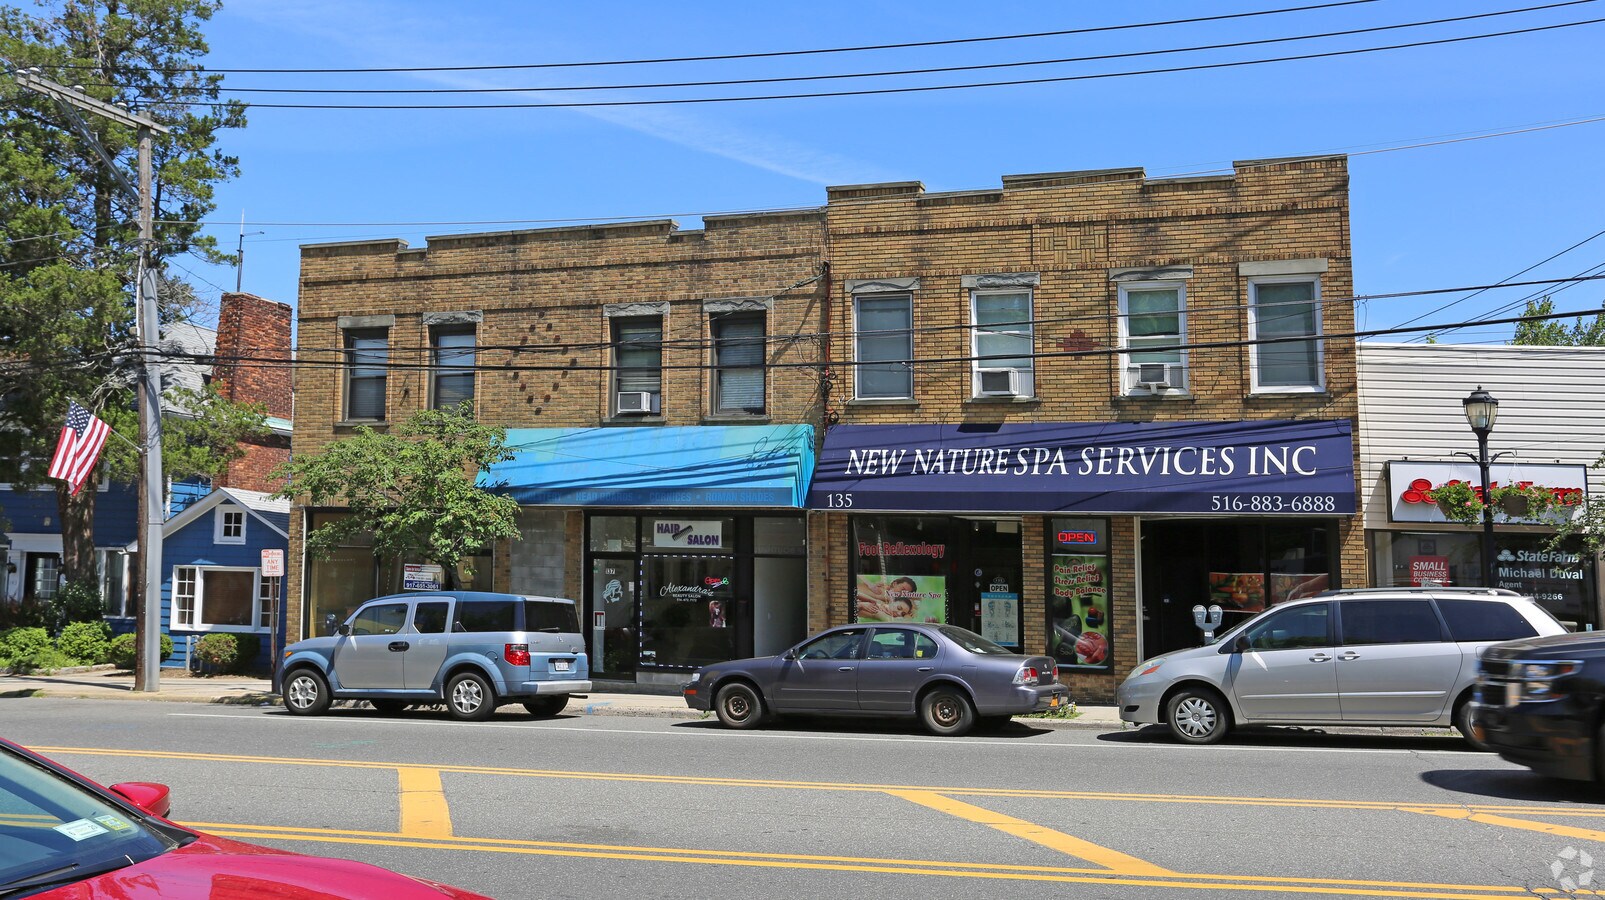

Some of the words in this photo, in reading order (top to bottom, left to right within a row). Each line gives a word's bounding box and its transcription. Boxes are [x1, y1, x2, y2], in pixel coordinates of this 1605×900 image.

[844, 448, 907, 475] NEW
[910, 448, 1011, 476] NATURE
[1013, 447, 1069, 476] SPA
[1078, 446, 1235, 476] SERVICES
[1247, 445, 1317, 476] INC
[705, 491, 737, 502] ROMAN
[740, 491, 775, 502] SHADES
[827, 493, 853, 508] 135
[1211, 495, 1336, 512] 516-883-6888
[656, 523, 681, 534] HAIR
[687, 534, 719, 546] SALON
[1057, 531, 1095, 543] OPEN
[859, 541, 882, 557] Foot
[882, 541, 945, 559] Reflexology
[1516, 550, 1548, 562] State
[1054, 564, 1071, 574] Pain
[1073, 562, 1096, 573] Relief
[1412, 561, 1446, 571] SMALL
[1054, 575, 1075, 585] Stress
[1076, 573, 1100, 584] Relief
[1413, 570, 1447, 578] BUSINESS
[1498, 567, 1545, 578] Michael
[1549, 568, 1583, 580] Duval
[660, 582, 714, 597] Alexandra's
[1498, 580, 1522, 589] Agent
[928, 591, 942, 599] Spa
[1054, 586, 1074, 599] Body
[1075, 585, 1107, 595] Balance
